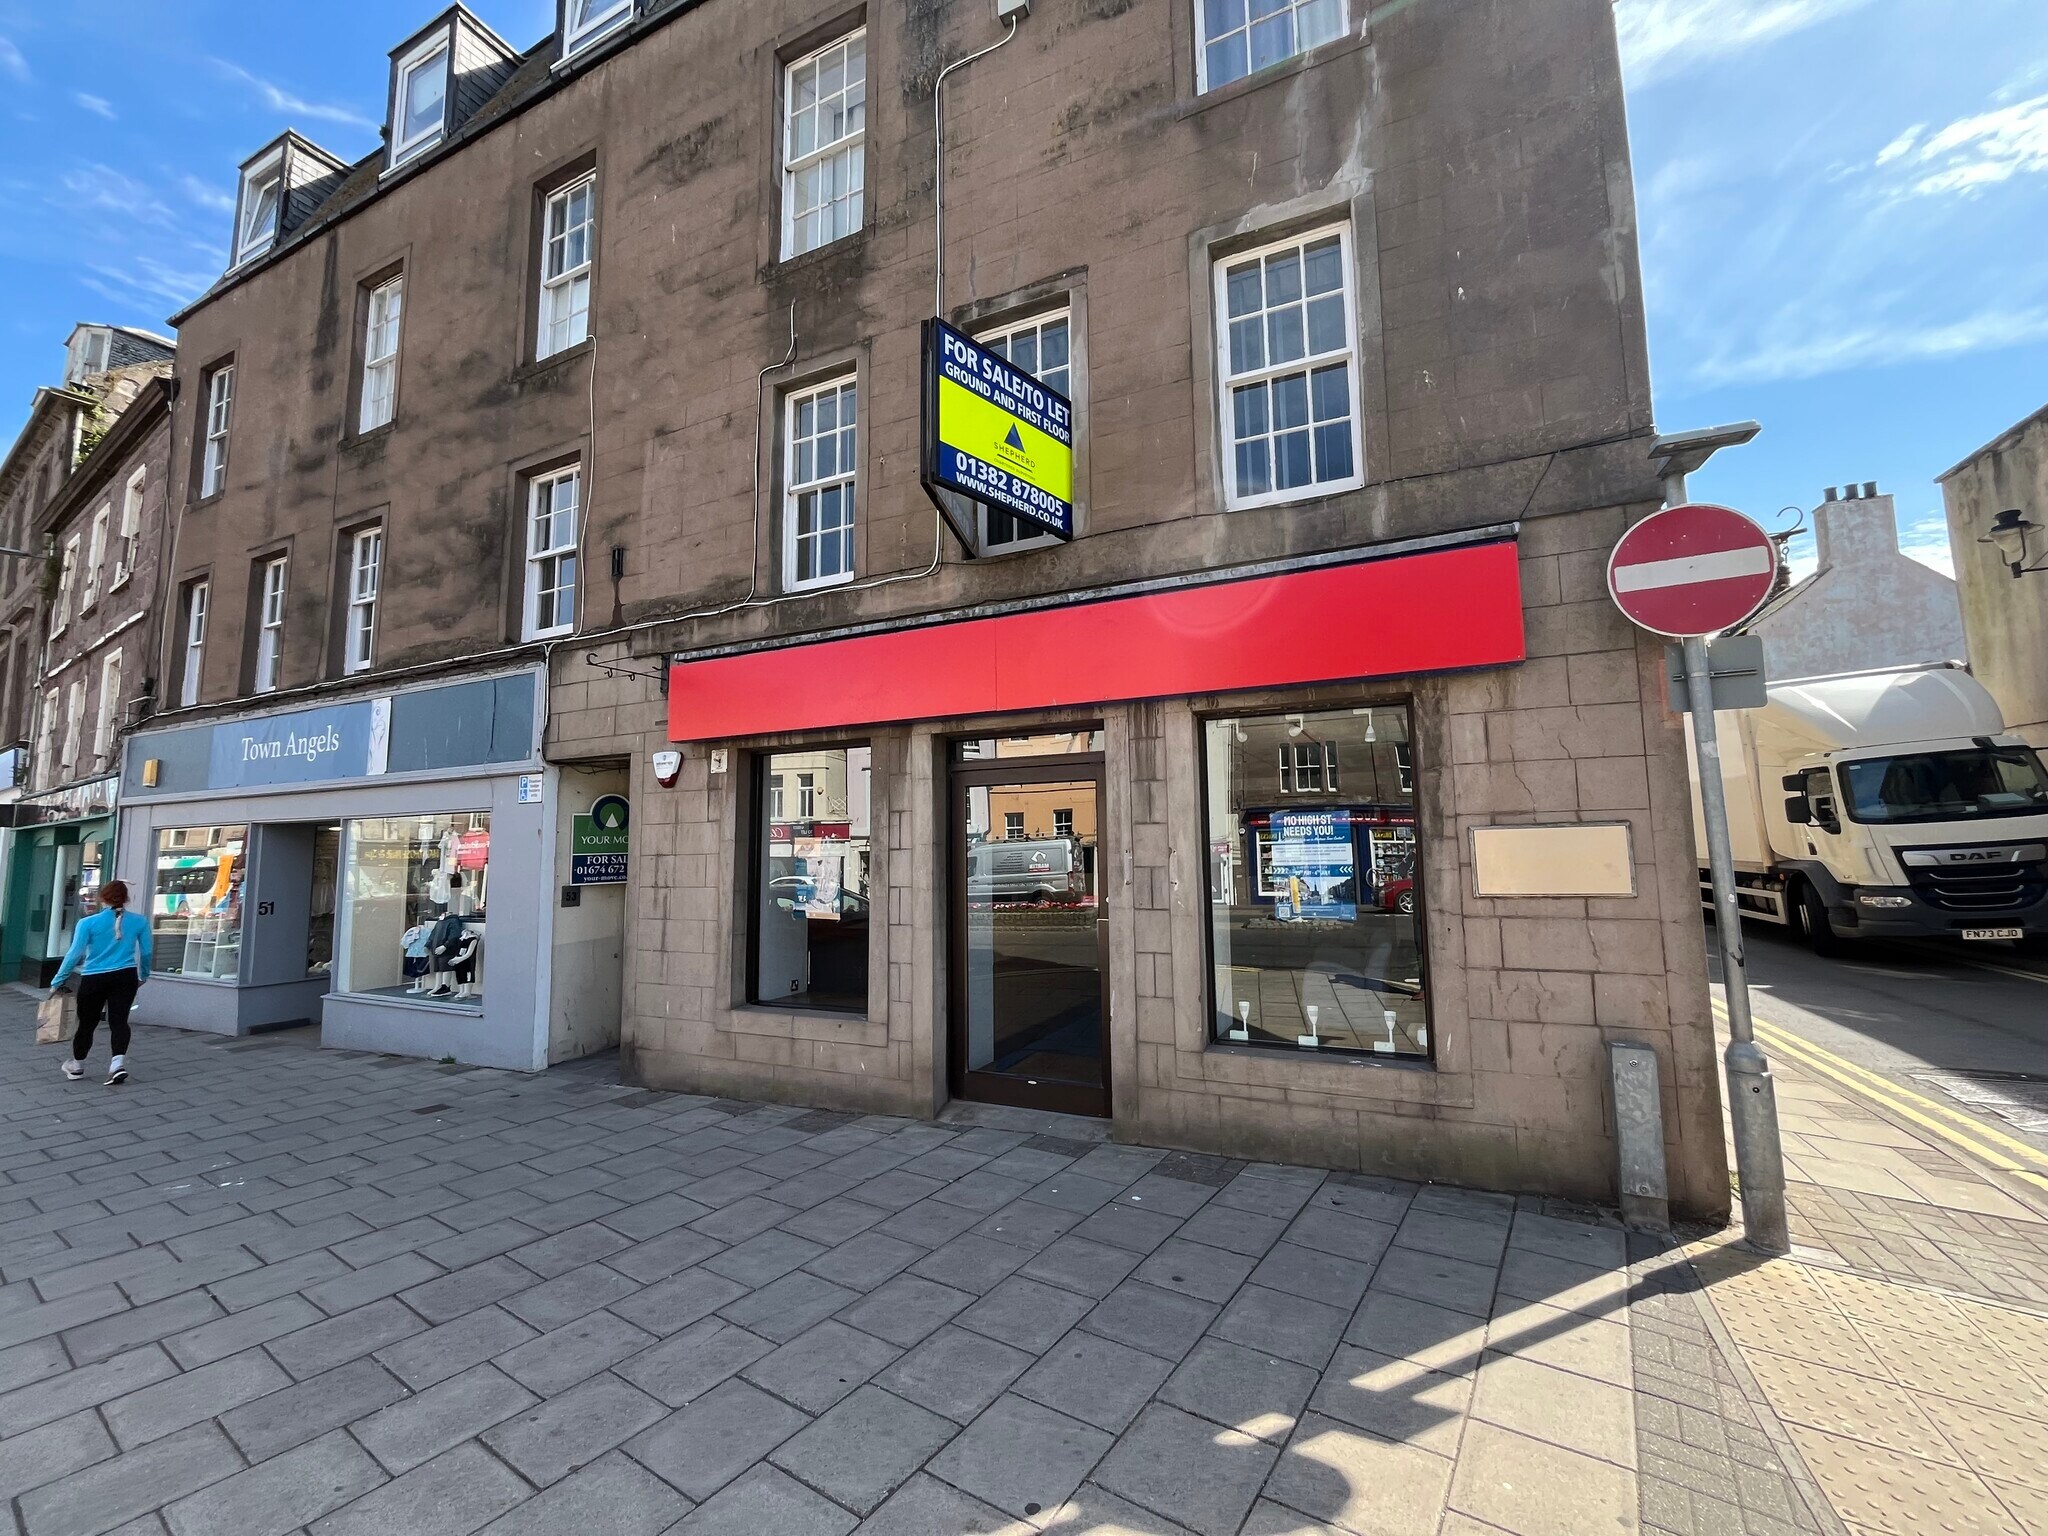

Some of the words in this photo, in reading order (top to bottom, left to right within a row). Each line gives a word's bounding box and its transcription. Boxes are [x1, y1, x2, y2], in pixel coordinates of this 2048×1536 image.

[944, 333, 978, 372] FOR
[982, 358, 1044, 410] SALE/TO
[1047, 397, 1070, 426] LET
[945, 361, 991, 397] GROUND
[993, 389, 1015, 411] AND
[1017, 402, 1042, 426] FIRST
[1043, 417, 1070, 443] FLOOR
[994, 442, 1036, 468] SHEPHERD
[956, 452, 1007, 490] 01382
[1012, 478, 1063, 517] 878005
[956, 471, 1063, 530] WWW.SHEPHERD.CO.UK
[242, 737, 281, 761] Town
[284, 725, 339, 762] Angels
[1284, 815, 1297, 826] MO
[1299, 815, 1319, 826] HIGH
[1320, 815, 1332, 825] ST
[1284, 826, 1312, 836] NEEDS
[1313, 826, 1334, 835] YOU!
[581, 835, 610, 844] YOUR
[587, 855, 609, 864] FOR
[1949, 851, 2002, 860] DAF
[577, 865, 605, 874] 01674
[608, 865, 625, 873] 672
[565, 892, 577, 901] 53
[258, 901, 275, 915] 51
[1966, 930, 1995, 938] FN73
